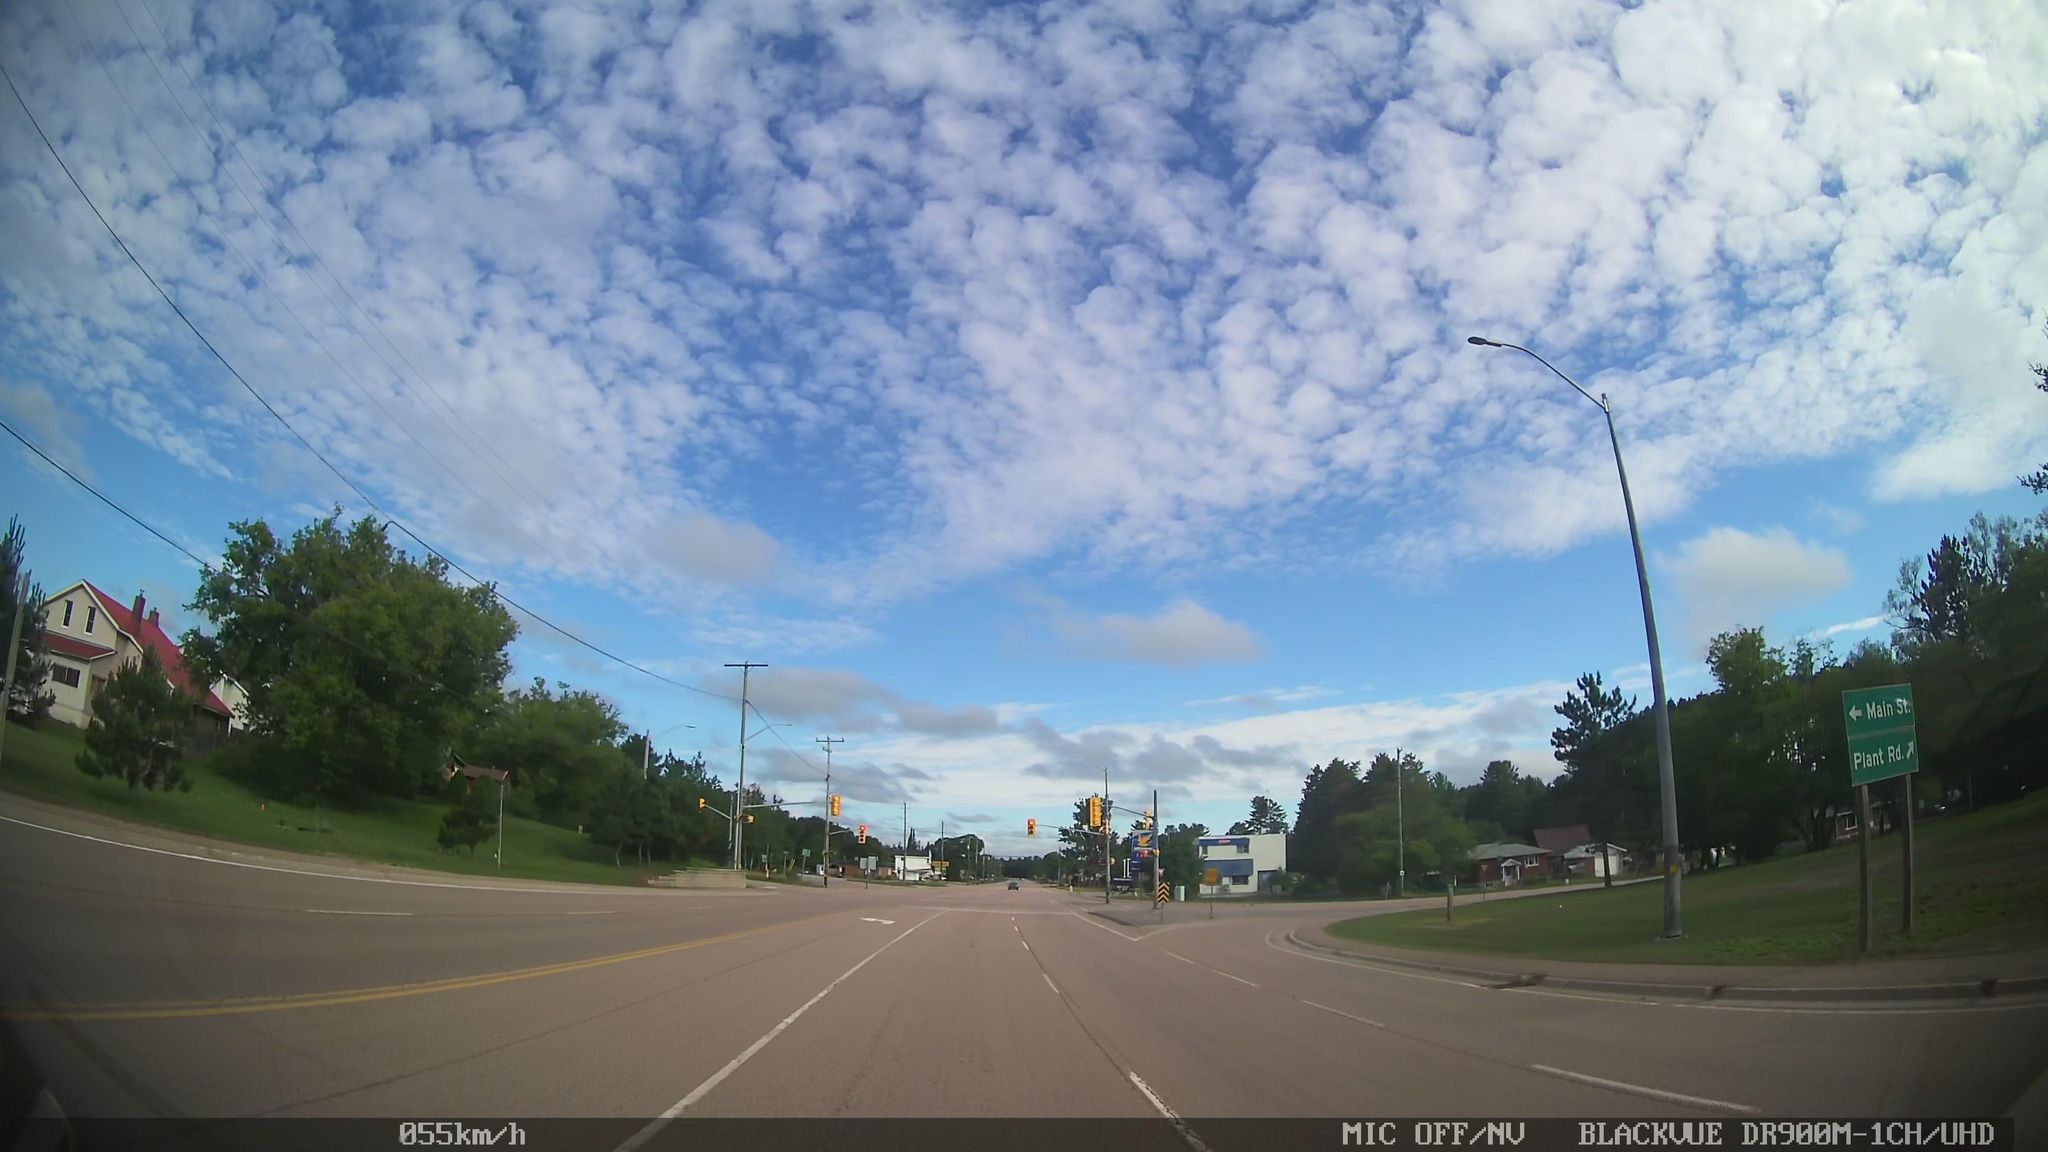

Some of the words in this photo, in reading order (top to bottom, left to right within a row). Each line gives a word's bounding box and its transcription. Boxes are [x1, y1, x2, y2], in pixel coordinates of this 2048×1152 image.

[1866, 701, 1893, 720] Main
[1896, 698, 1911, 715] St.
[1853, 748, 1884, 770] Plant
[1888, 744, 1904, 763] Rd.
